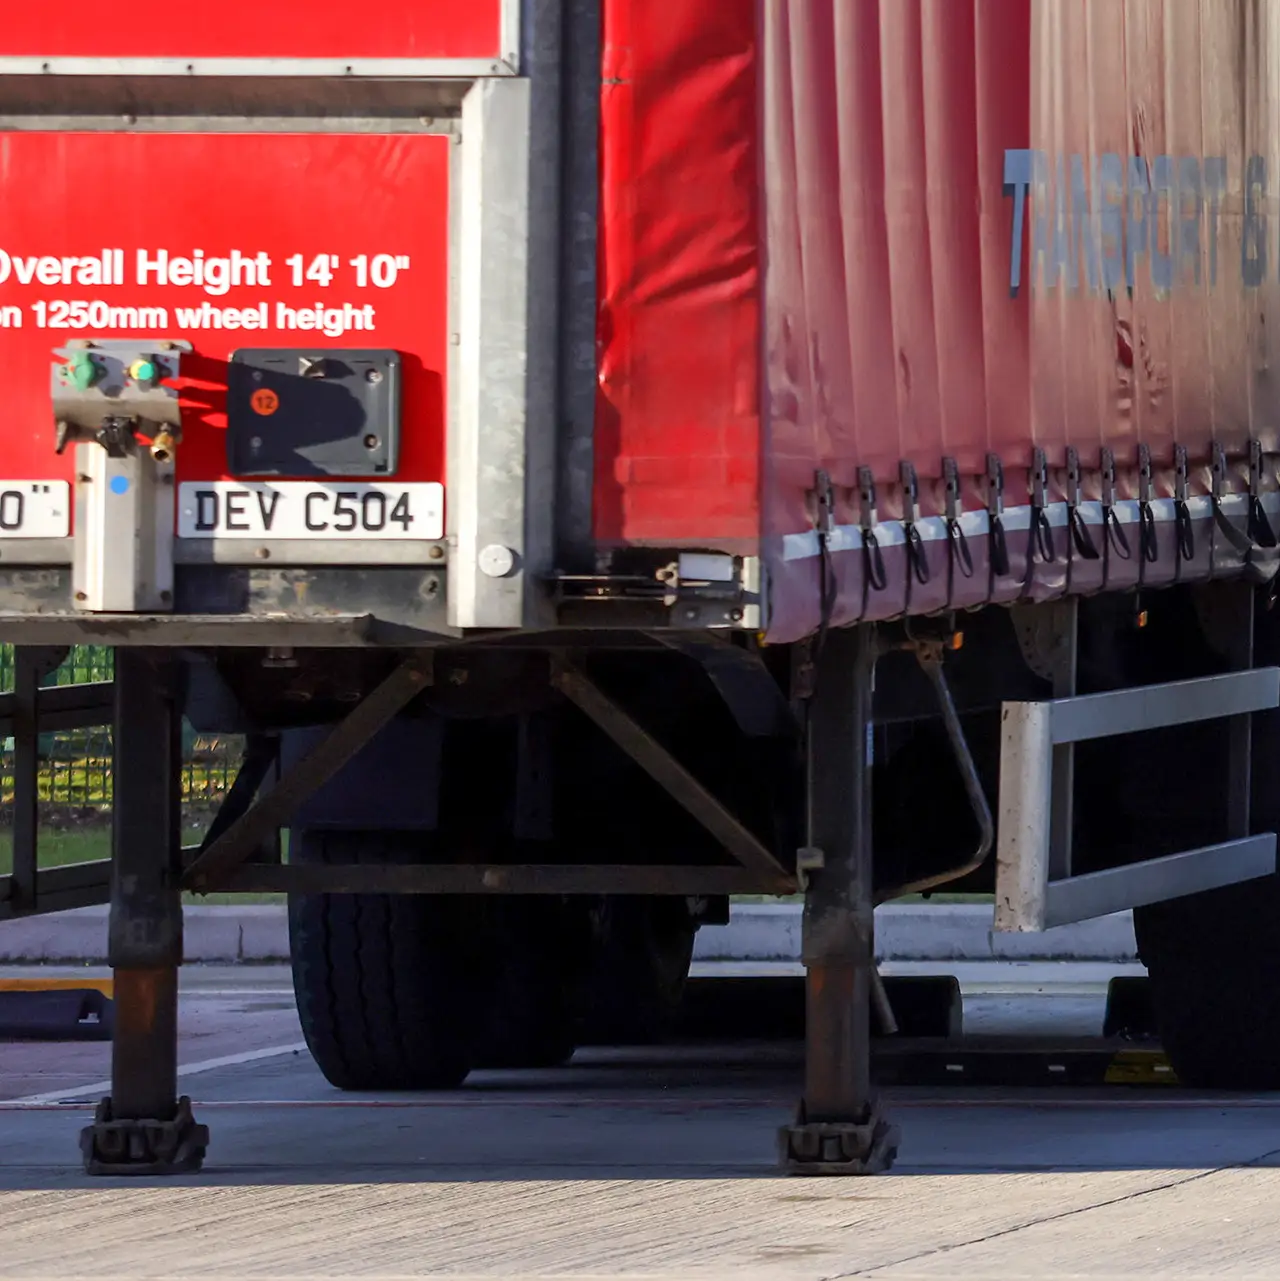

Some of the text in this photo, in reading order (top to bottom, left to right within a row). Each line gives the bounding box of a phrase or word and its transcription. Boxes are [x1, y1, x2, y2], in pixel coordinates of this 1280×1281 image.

[1002, 148, 1228, 294] TRANSPORT
[136, 248, 272, 296] Height
[285, 253, 340, 287] 14'
[349, 253, 411, 288] 10"
[31, 300, 168, 329] 1250mm
[175, 302, 268, 330] wheel
[276, 302, 376, 337] height
[256, 395, 275, 410] 12
[194, 490, 414, 532] DEV C504
